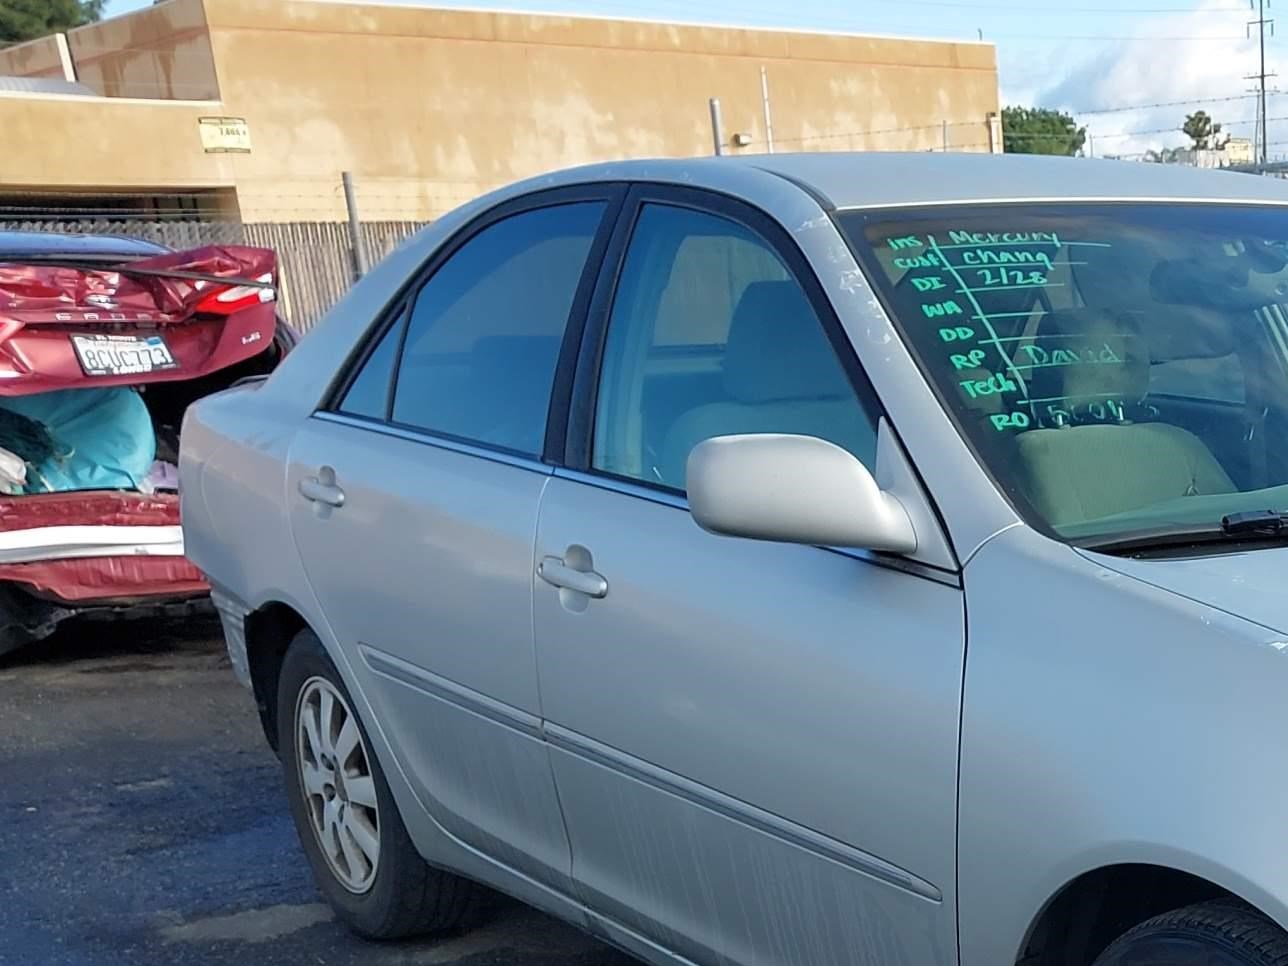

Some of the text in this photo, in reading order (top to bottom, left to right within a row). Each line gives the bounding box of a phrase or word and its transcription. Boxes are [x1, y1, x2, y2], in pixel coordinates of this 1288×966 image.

[948, 230, 1062, 248] Mercury
[938, 326, 975, 343] DD
[949, 343, 1121, 370] RP David
[990, 411, 1030, 431] RO
